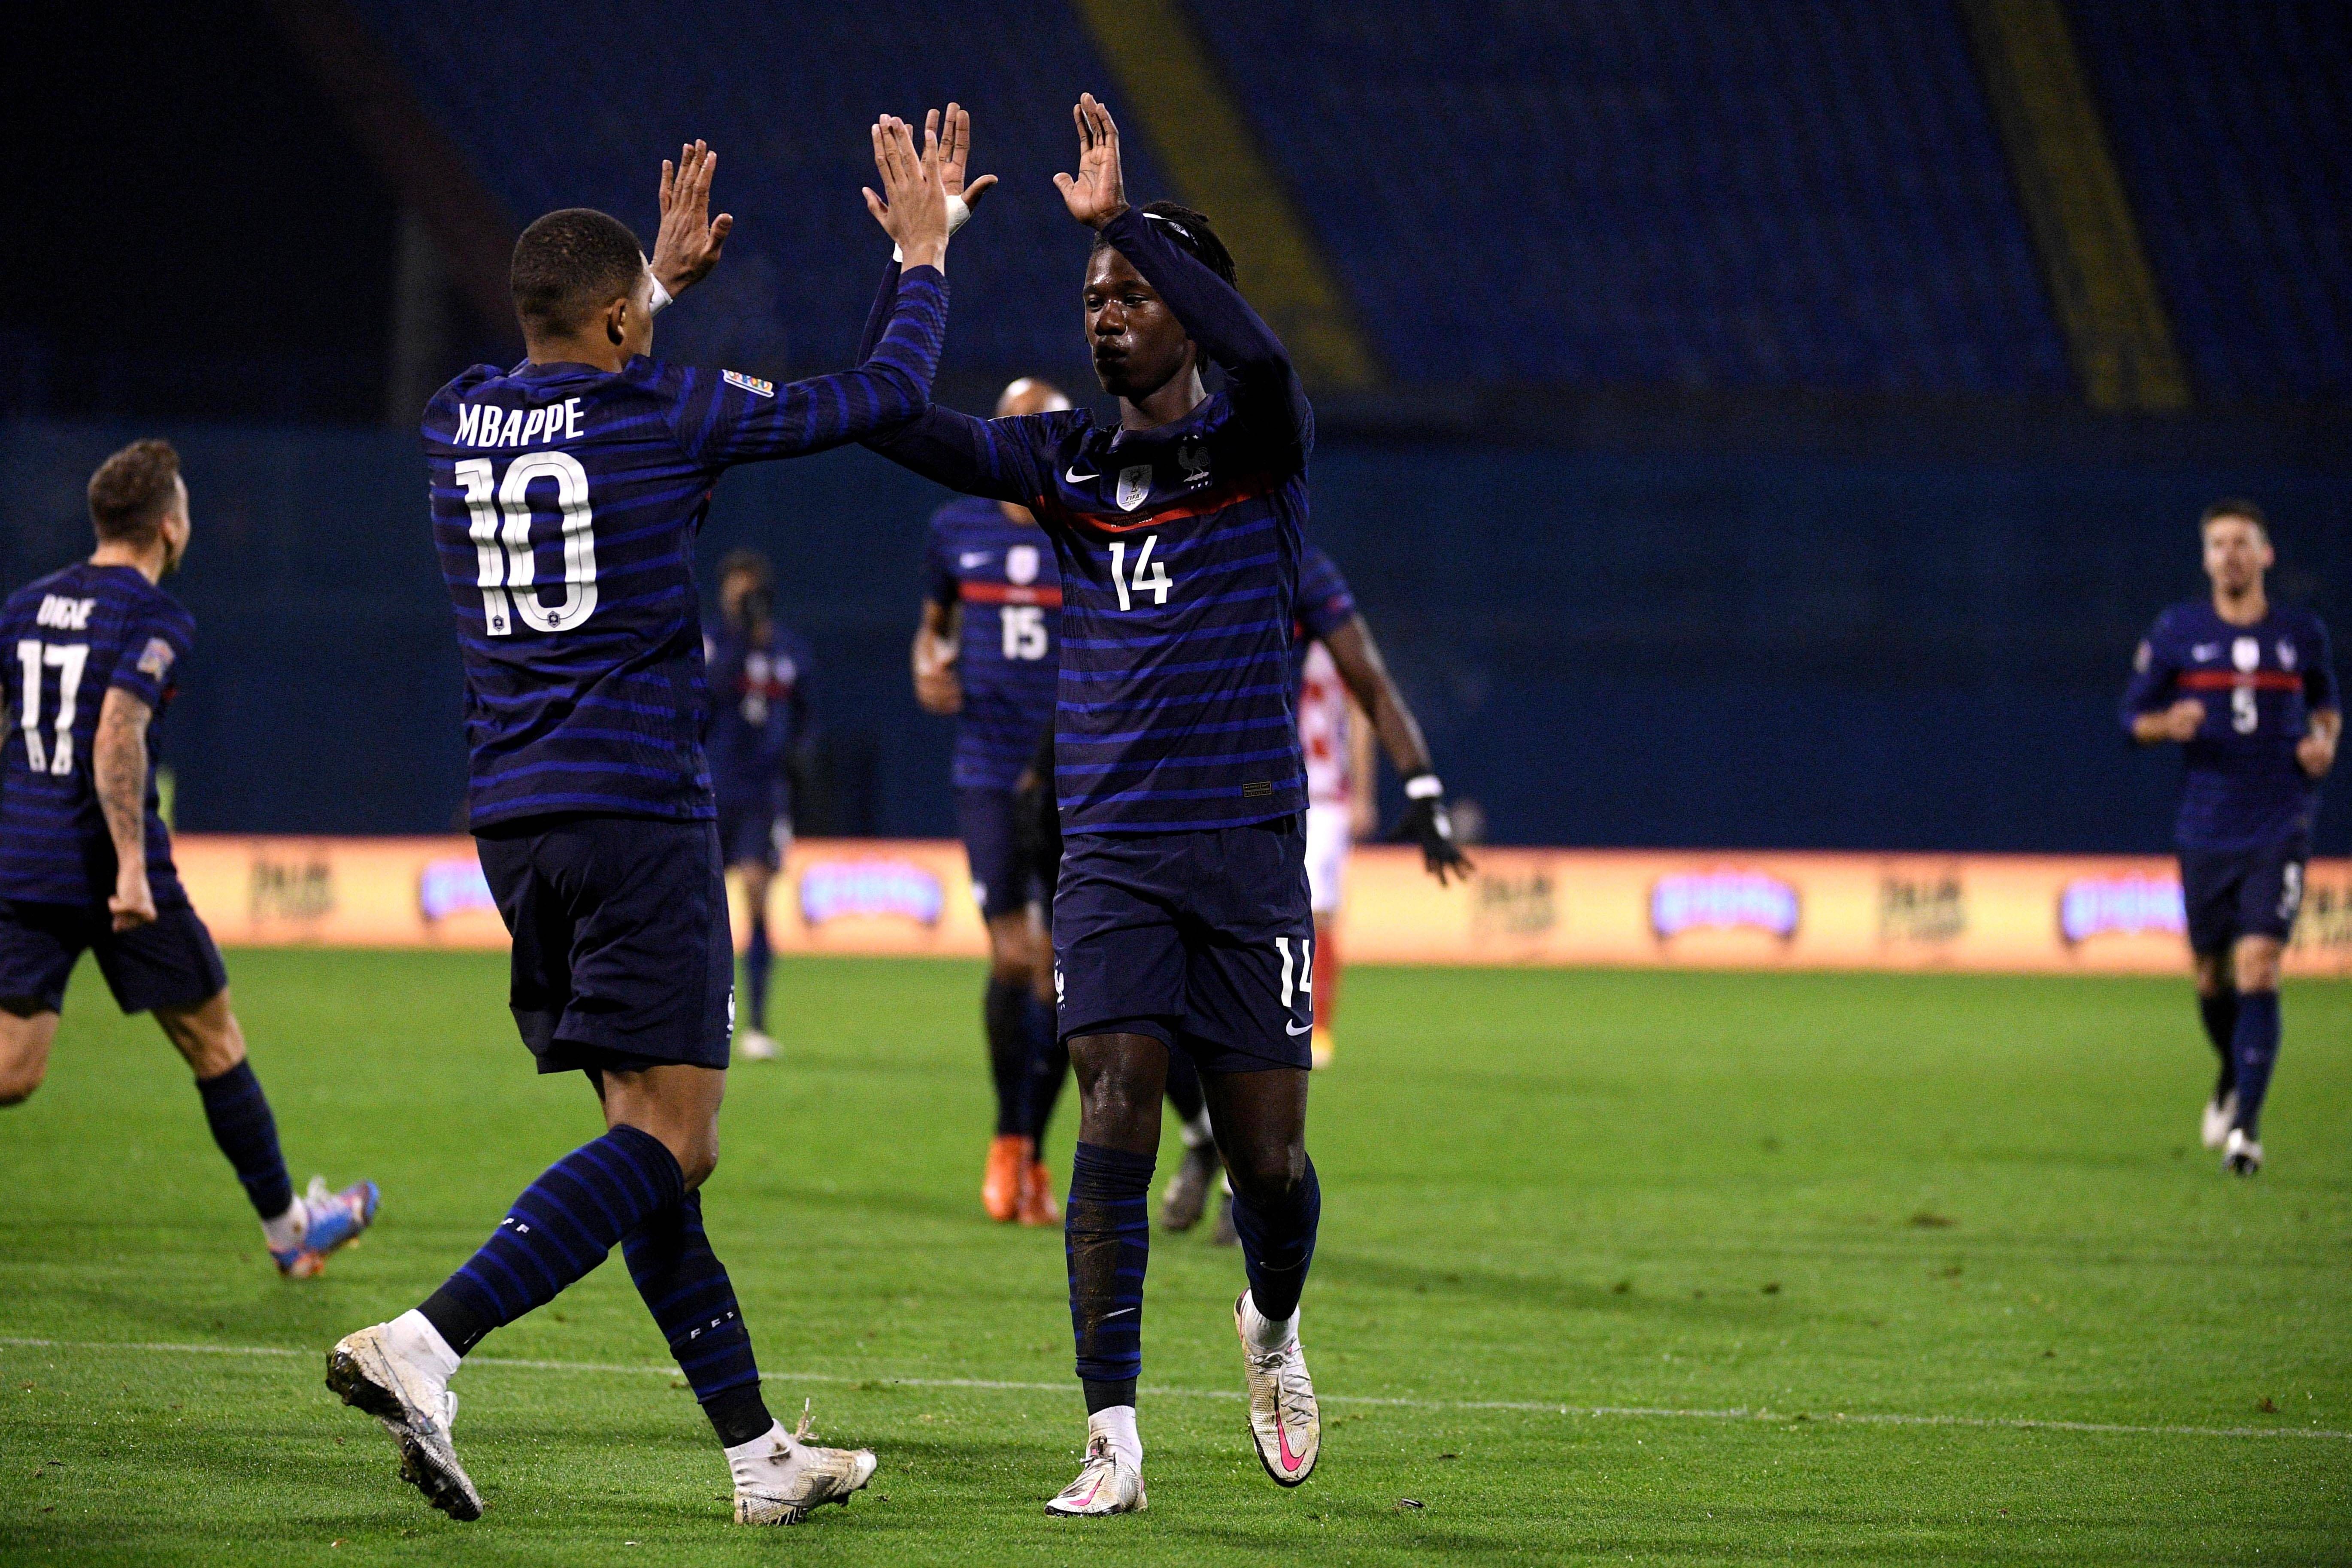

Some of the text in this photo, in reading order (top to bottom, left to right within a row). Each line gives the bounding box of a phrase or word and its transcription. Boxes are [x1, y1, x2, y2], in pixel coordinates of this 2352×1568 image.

[452, 397, 584, 447] MBAPPE
[455, 451, 598, 636] 10
[1109, 535, 1173, 612] 14
[1000, 606, 1049, 661] 15
[17, 639, 90, 776] 17
[1276, 937, 1313, 1011] 14
